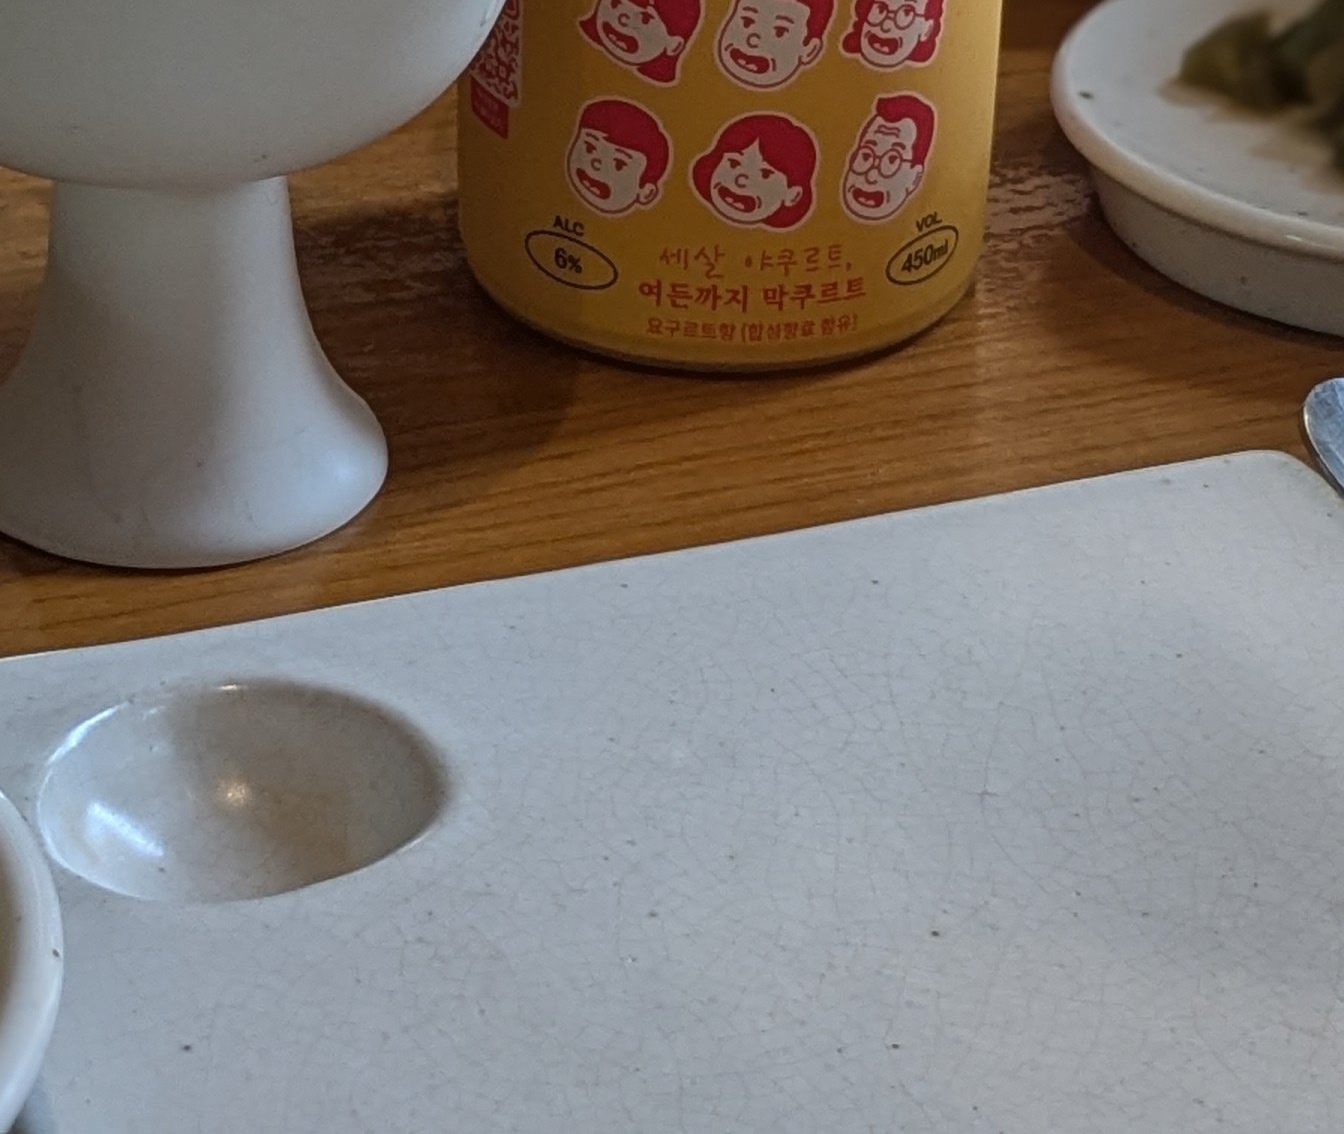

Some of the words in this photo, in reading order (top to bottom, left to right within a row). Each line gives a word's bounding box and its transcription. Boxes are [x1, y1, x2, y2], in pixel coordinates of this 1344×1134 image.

[553, 215, 584, 237] ALC
[916, 211, 943, 232] VOL
[555, 247, 583, 274] 6%
[659, 244, 725, 279] 세살
[901, 238, 949, 273] 450ml
[638, 279, 749, 313] 여든까지
[763, 276, 867, 311] 막쿠르트
[646, 317, 736, 343] 요구르트향
